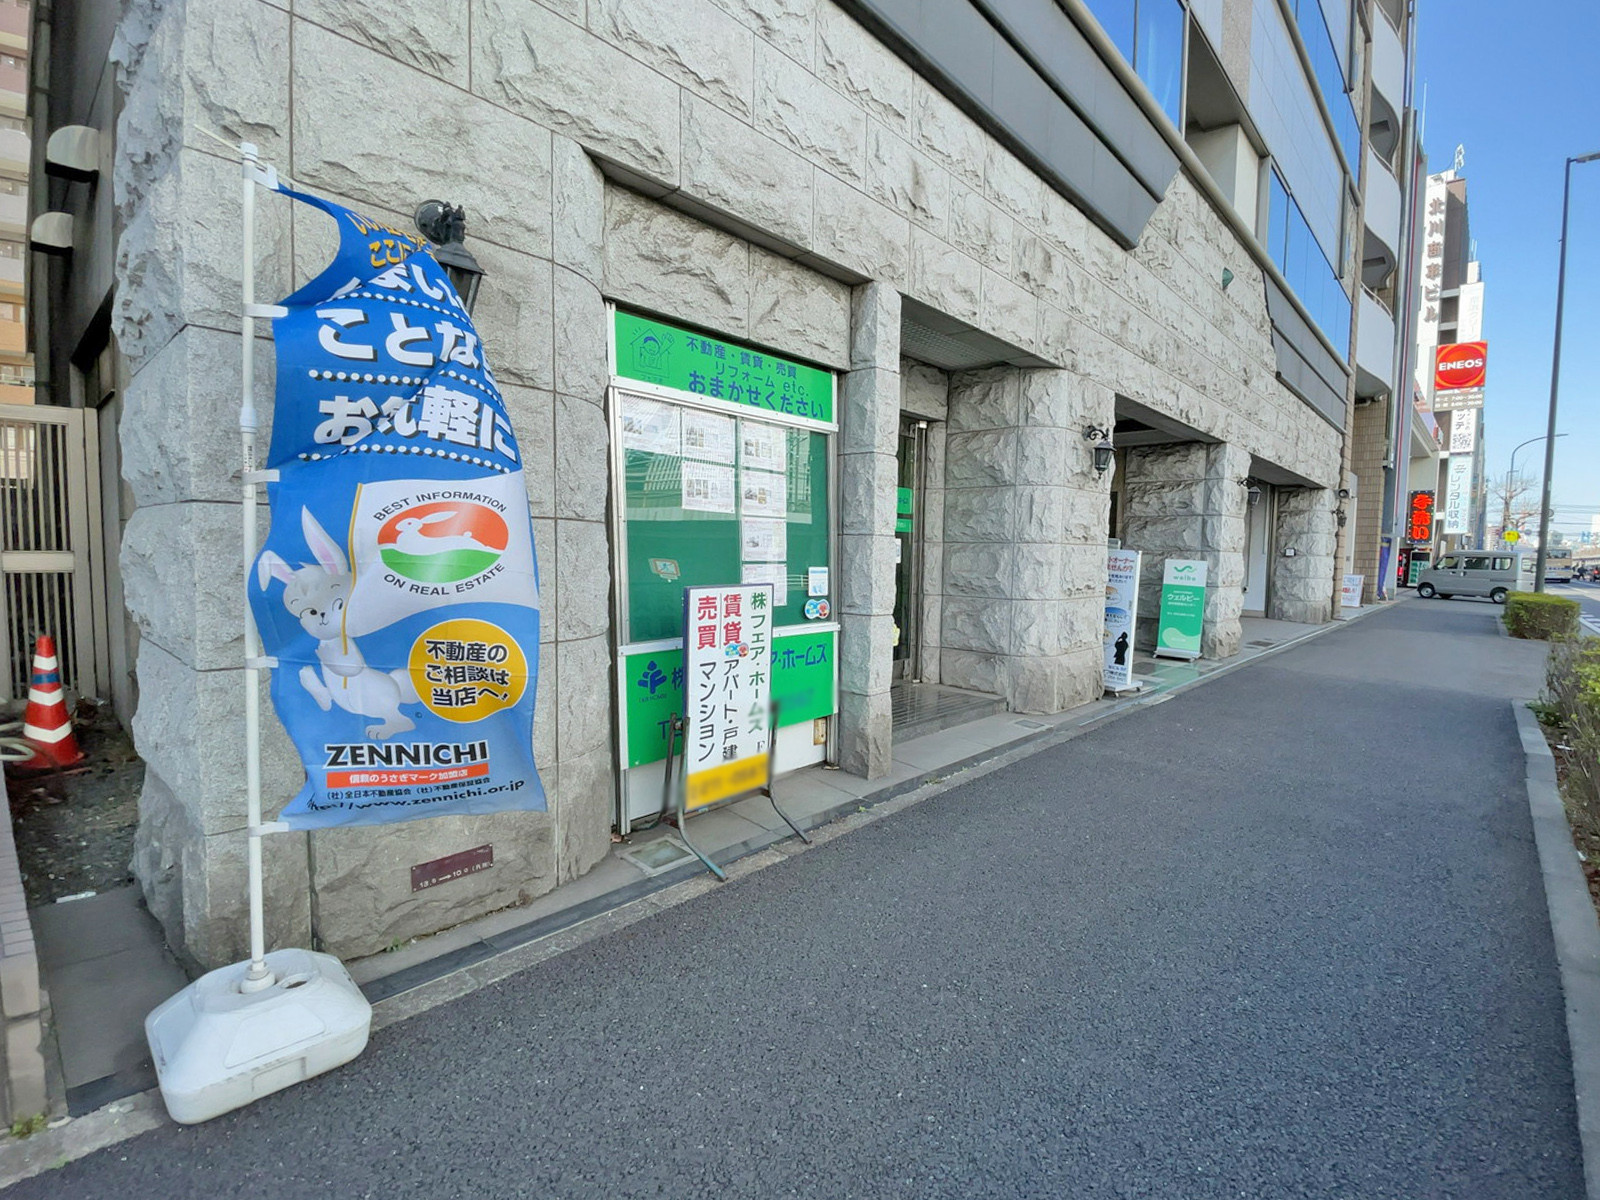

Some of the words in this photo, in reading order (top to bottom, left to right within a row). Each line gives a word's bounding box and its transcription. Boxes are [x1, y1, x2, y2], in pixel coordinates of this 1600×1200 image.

[715, 361, 775, 389] リフォーム
[783, 380, 810, 398] etc.
[1438, 358, 1484, 371] ENEOS
[689, 370, 823, 419] おまかせください
[373, 497, 411, 522] BEST
[415, 490, 508, 513] INFORMATION
[383, 573, 406, 590] ON
[409, 583, 450, 596] REAL
[455, 563, 506, 594] ESTATE
[1167, 593, 1200, 602] ウェルビー
[697, 595, 717, 650] 売買
[723, 594, 742, 646] 賃貸
[426, 640, 508, 662] 不動産の
[426, 664, 510, 686] ご相談は
[698, 662, 717, 762] マンション
[324, 740, 489, 768] ZENNICHI
[349, 768, 468, 784] 信頼のうさぎマーク加盟店
